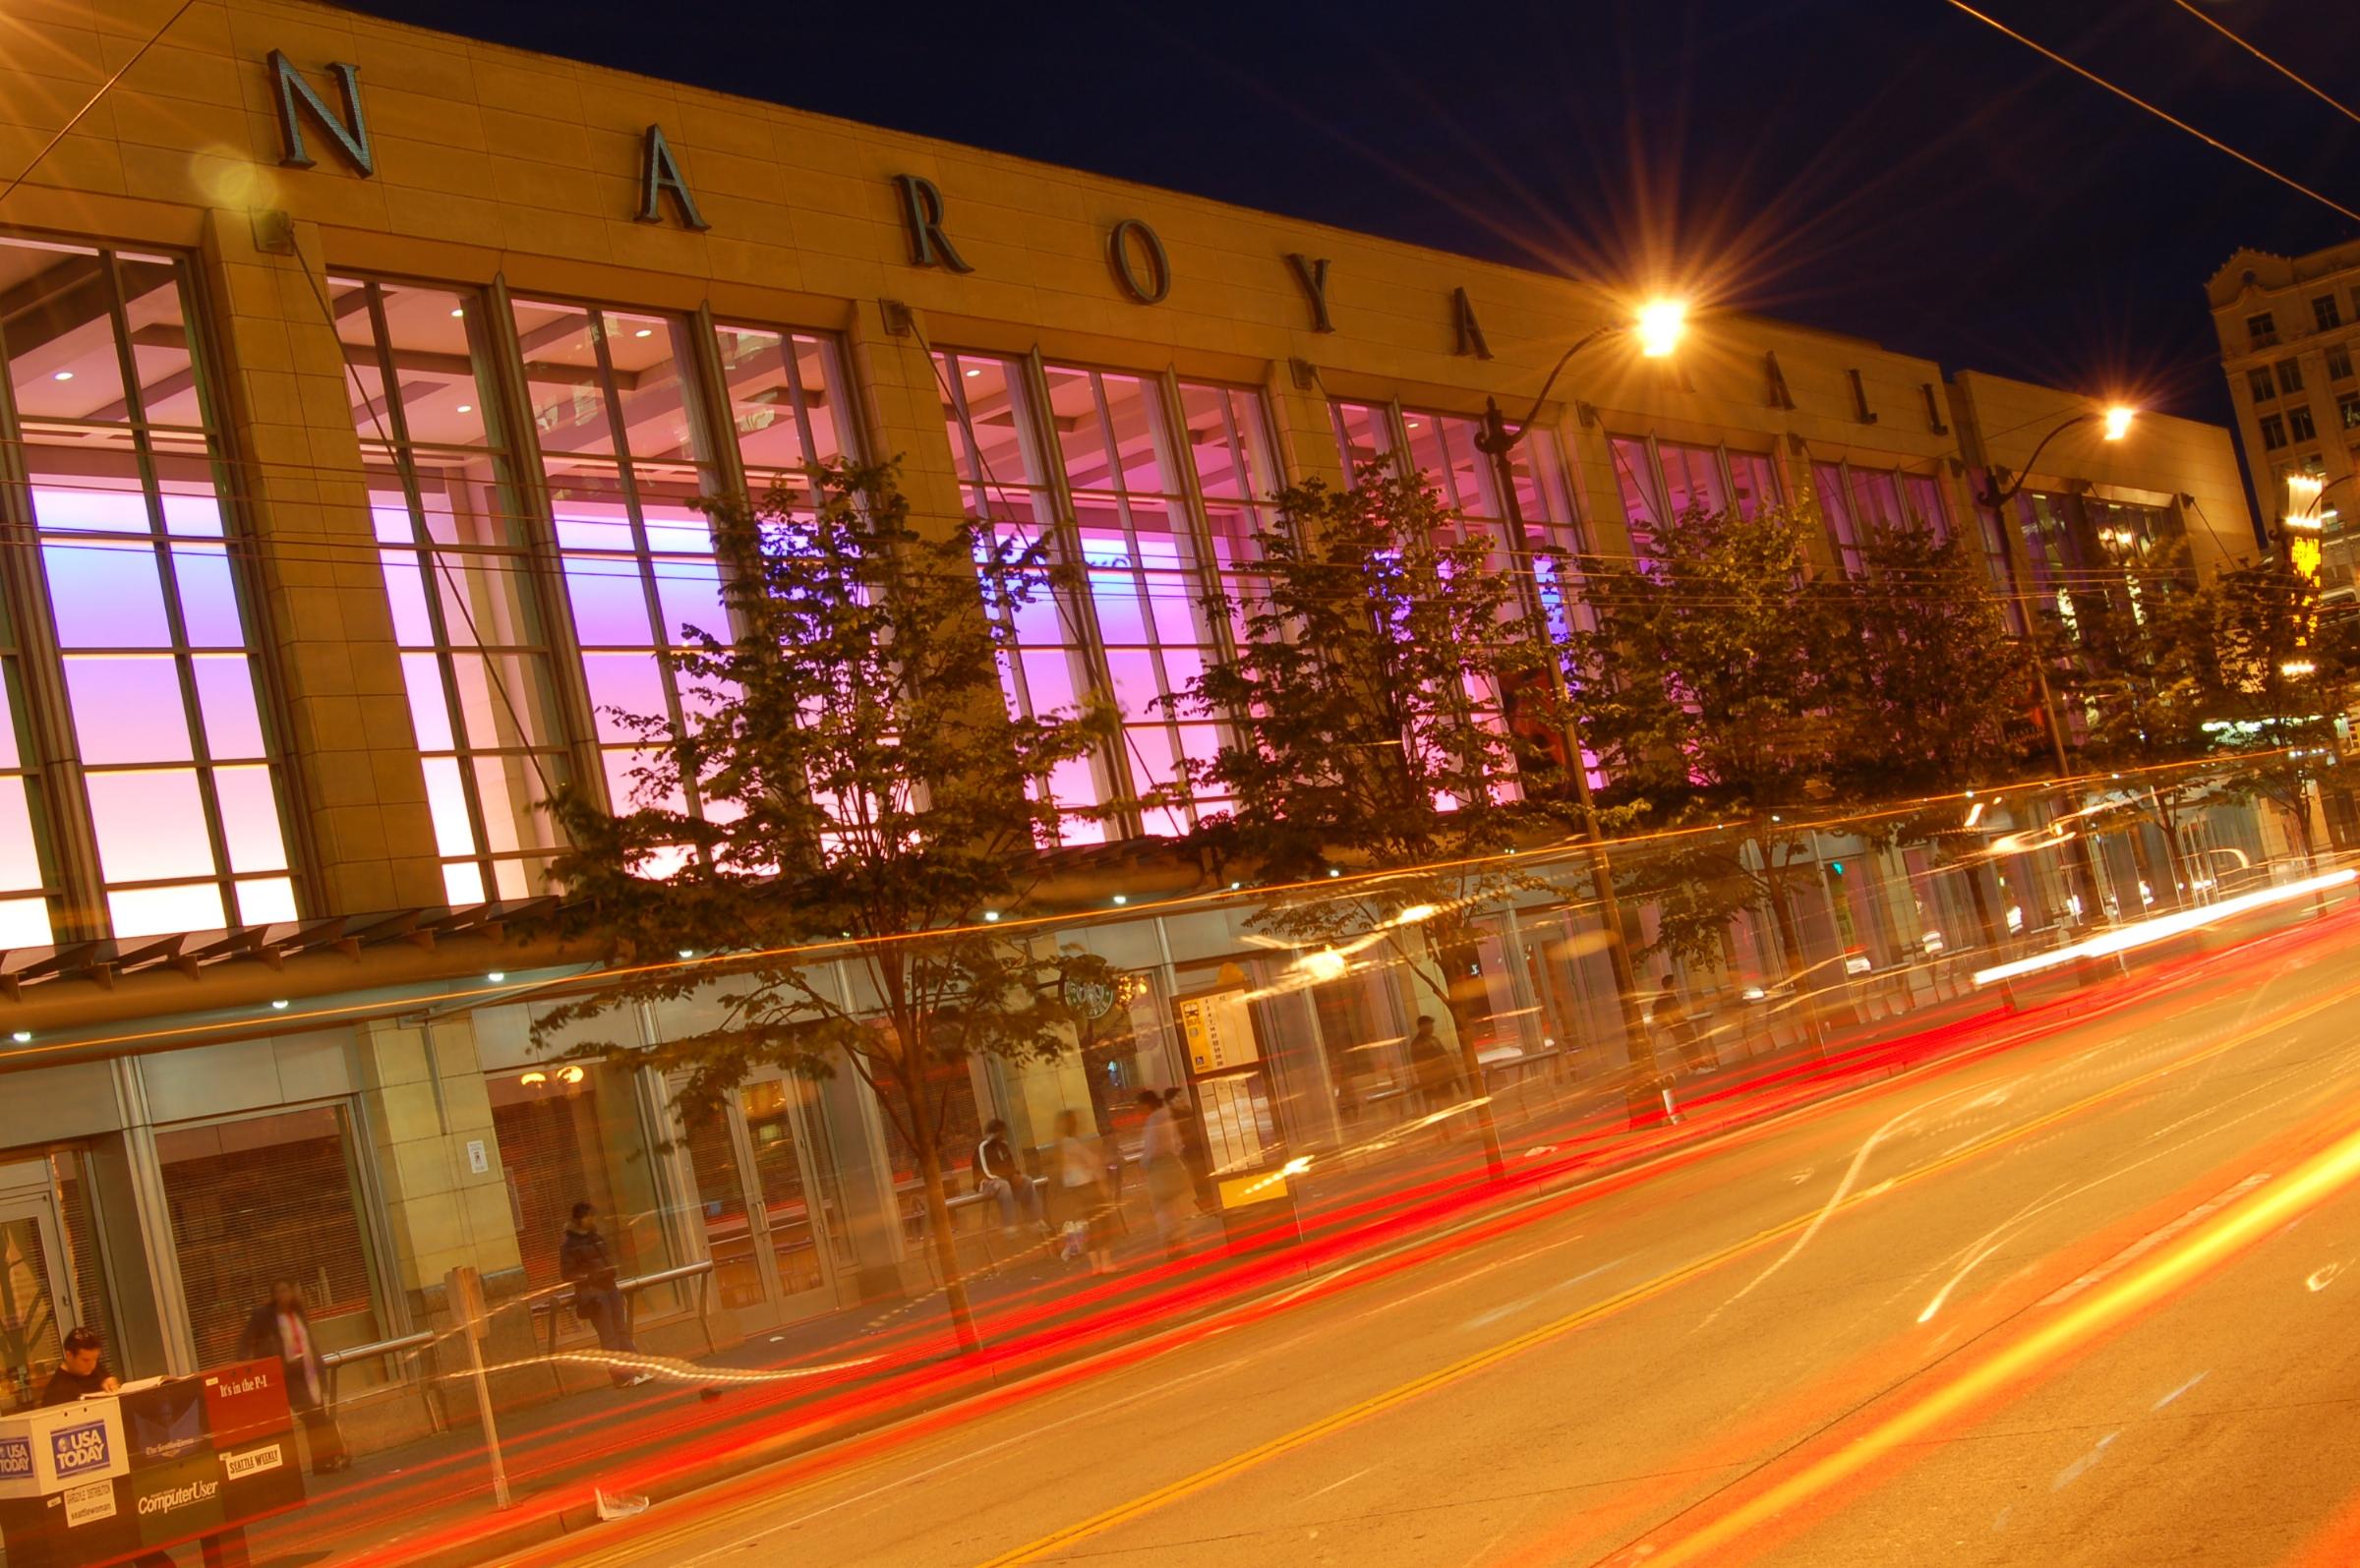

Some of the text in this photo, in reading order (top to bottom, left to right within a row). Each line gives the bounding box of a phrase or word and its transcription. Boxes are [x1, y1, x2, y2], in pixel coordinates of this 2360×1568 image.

[1682, 348, 1949, 436] ALL
[219, 1384, 233, 1397] It's
[232, 1381, 242, 1395] in
[241, 1378, 254, 1392] the
[254, 1374, 267, 1389] P-I
[7, 1444, 28, 1458] USA
[70, 1429, 102, 1450] USA
[0, 1457, 30, 1472] TODAY
[57, 1443, 105, 1470] TODAY
[228, 1450, 278, 1474] SEATTLE WEEKLY
[138, 1480, 218, 1515] ComputerUser
